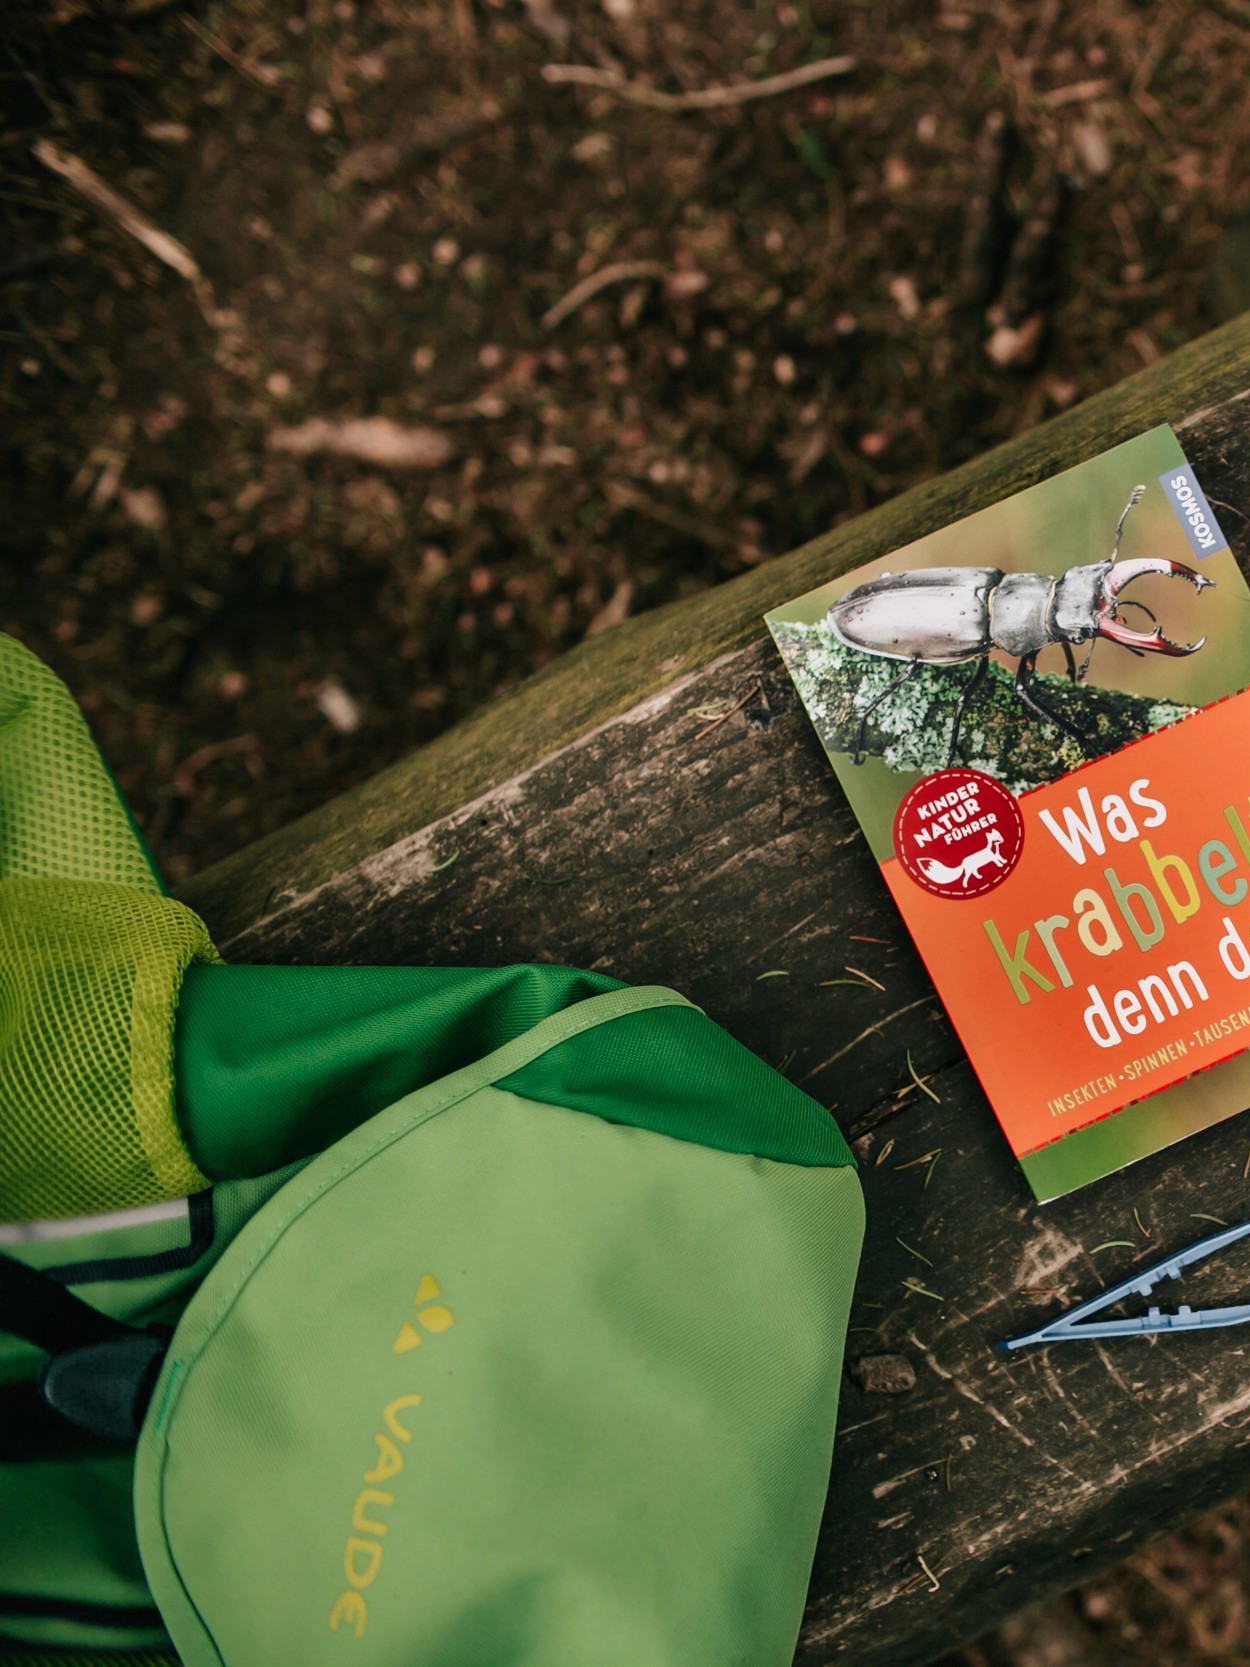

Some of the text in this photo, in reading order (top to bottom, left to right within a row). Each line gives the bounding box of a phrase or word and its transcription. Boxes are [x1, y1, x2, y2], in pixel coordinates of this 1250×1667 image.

[1170, 475, 1217, 549] KOSMOS
[913, 798, 981, 848] NATUR
[916, 781, 980, 820] KINDER
[943, 813, 998, 845] FÜHRER
[1038, 779, 1167, 865] Was
[1083, 960, 1209, 1048] denn
[1047, 1073, 1117, 1117] INSEKTEN
[1123, 1039, 1188, 1080] SPINNEN
[328, 1393, 422, 1639] VAUDE
